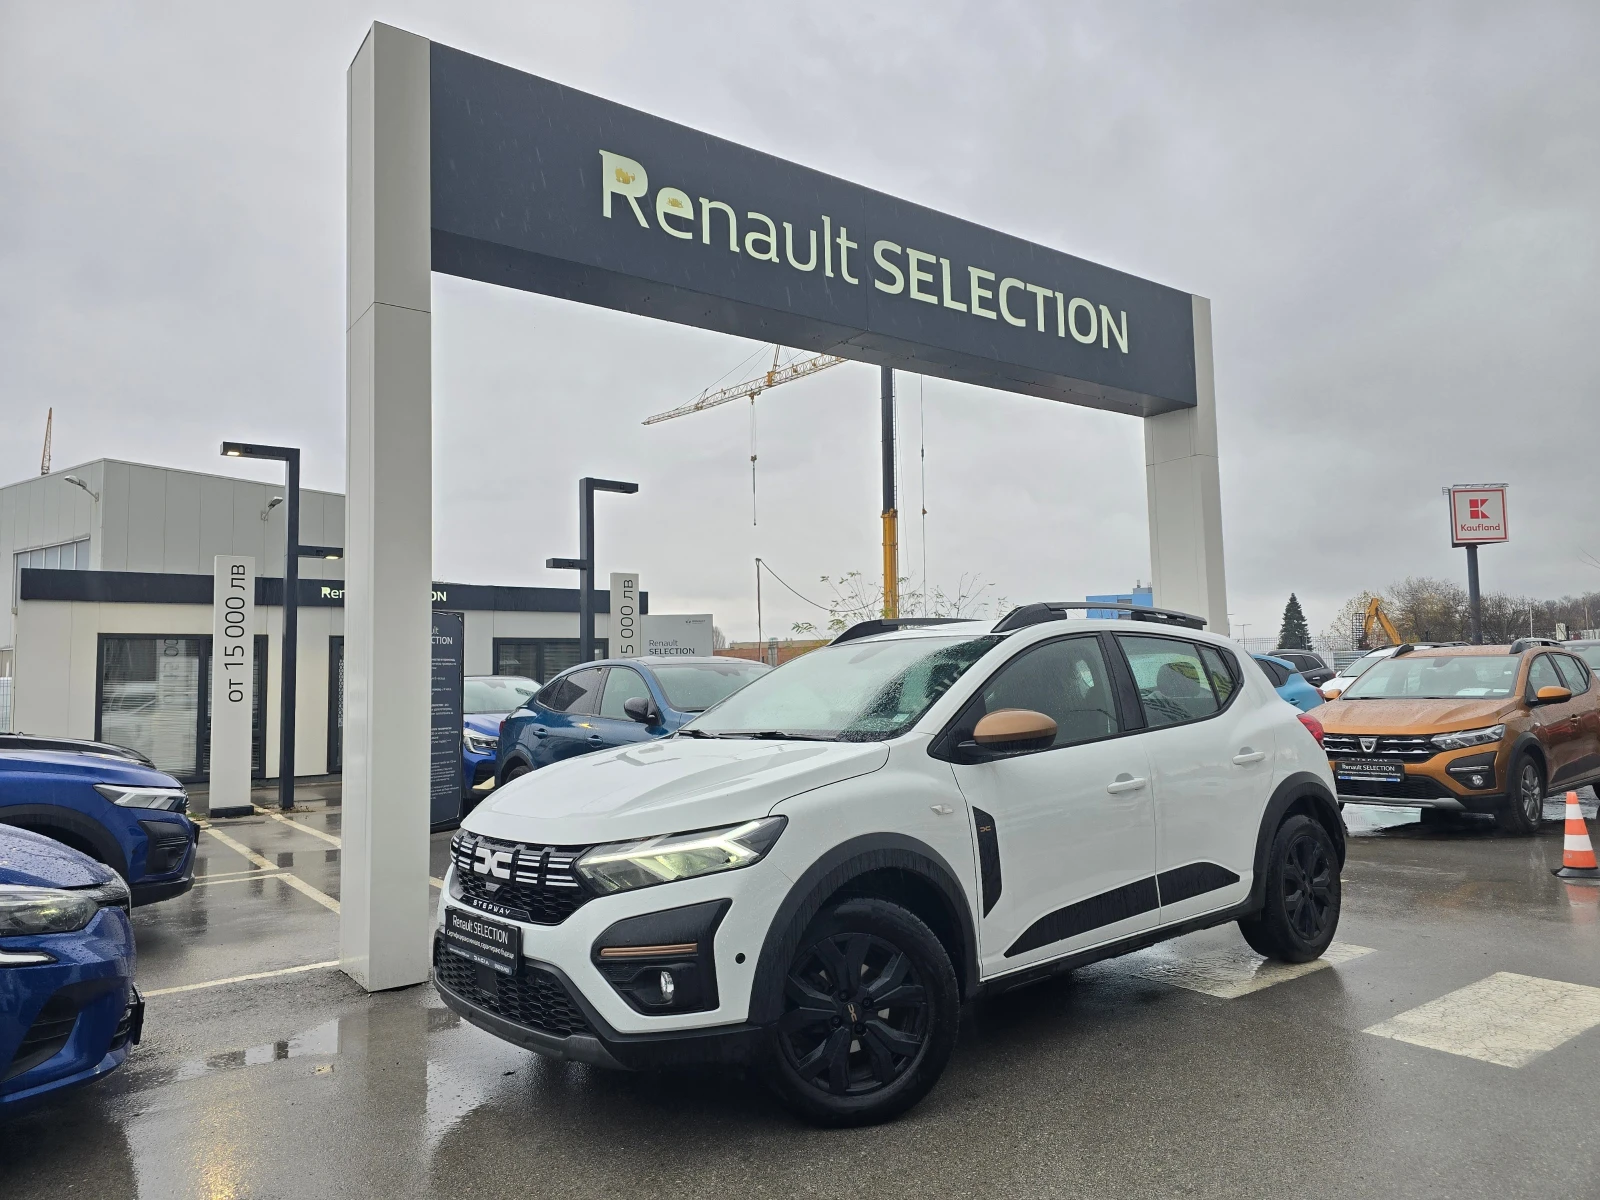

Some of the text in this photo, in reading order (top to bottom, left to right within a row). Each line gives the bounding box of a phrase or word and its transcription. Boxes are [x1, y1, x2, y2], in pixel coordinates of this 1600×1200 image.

[599, 149, 1129, 354] Renault SELECTION
[1460, 523, 1501, 532] Kaufland
[224, 596, 246, 639] 000
[620, 605, 634, 639] 000
[649, 639, 678, 647] Renault
[224, 645, 245, 671] 15
[473, 899, 510, 915] STEPWAY
[452, 914, 509, 944] Renault SELECTION
